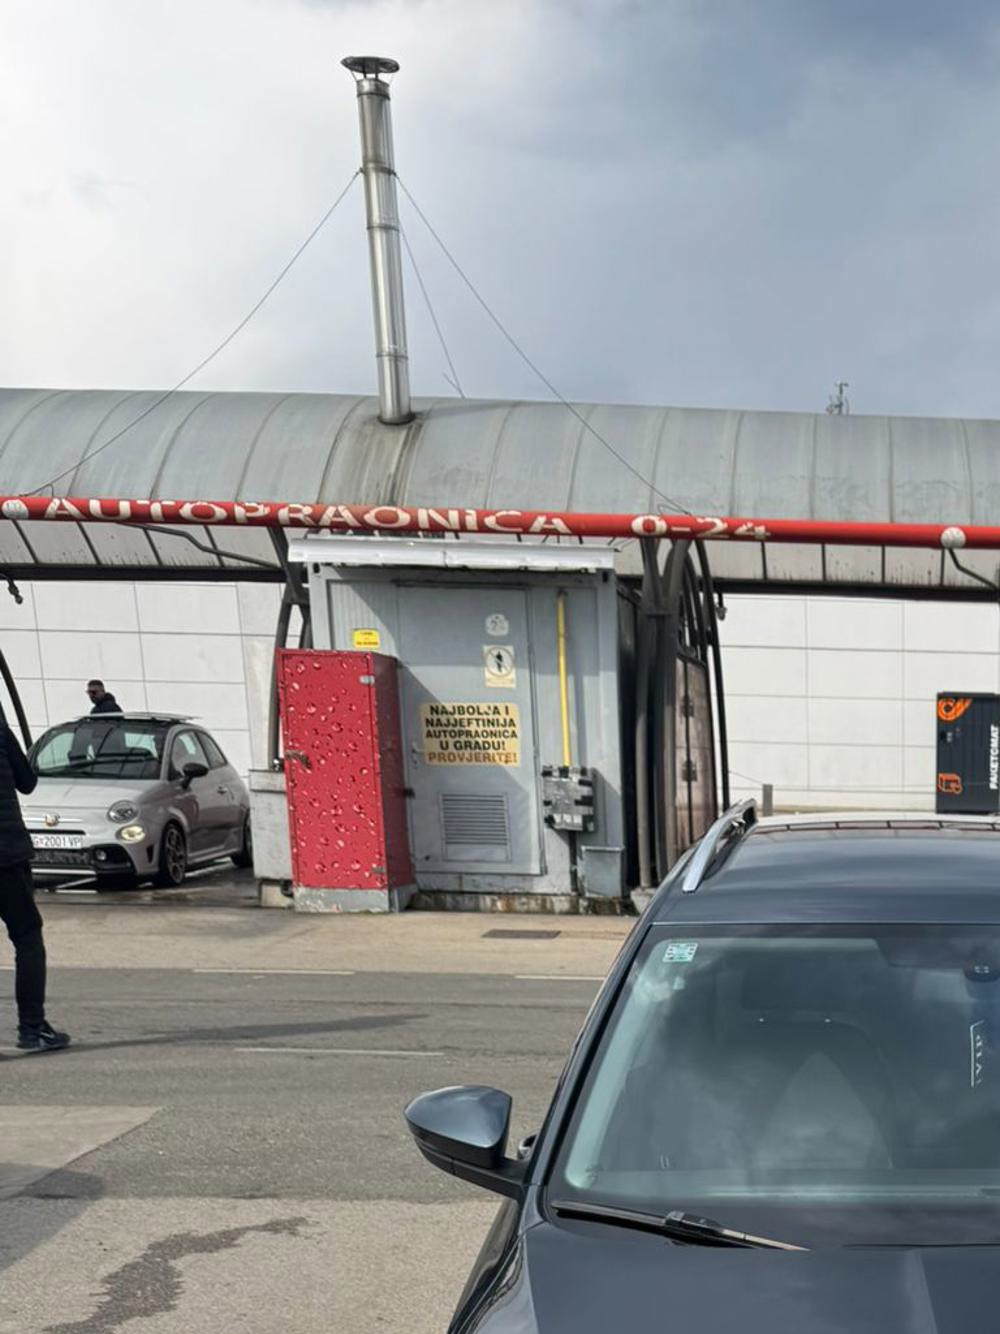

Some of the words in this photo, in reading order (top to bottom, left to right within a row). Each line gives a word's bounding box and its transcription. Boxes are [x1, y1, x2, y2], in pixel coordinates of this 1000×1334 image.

[44, 497, 572, 534] AUTOPRAONICA
[630, 515, 771, 541] 0-24
[505, 705, 510, 715] I
[425, 718, 516, 728] NAJJEFTINIJA
[425, 729, 518, 739] AUTOPRAONICA
[440, 741, 449, 751] U
[453, 740, 506, 751] GRADU!
[427, 752, 518, 763] PROVJERITE!
